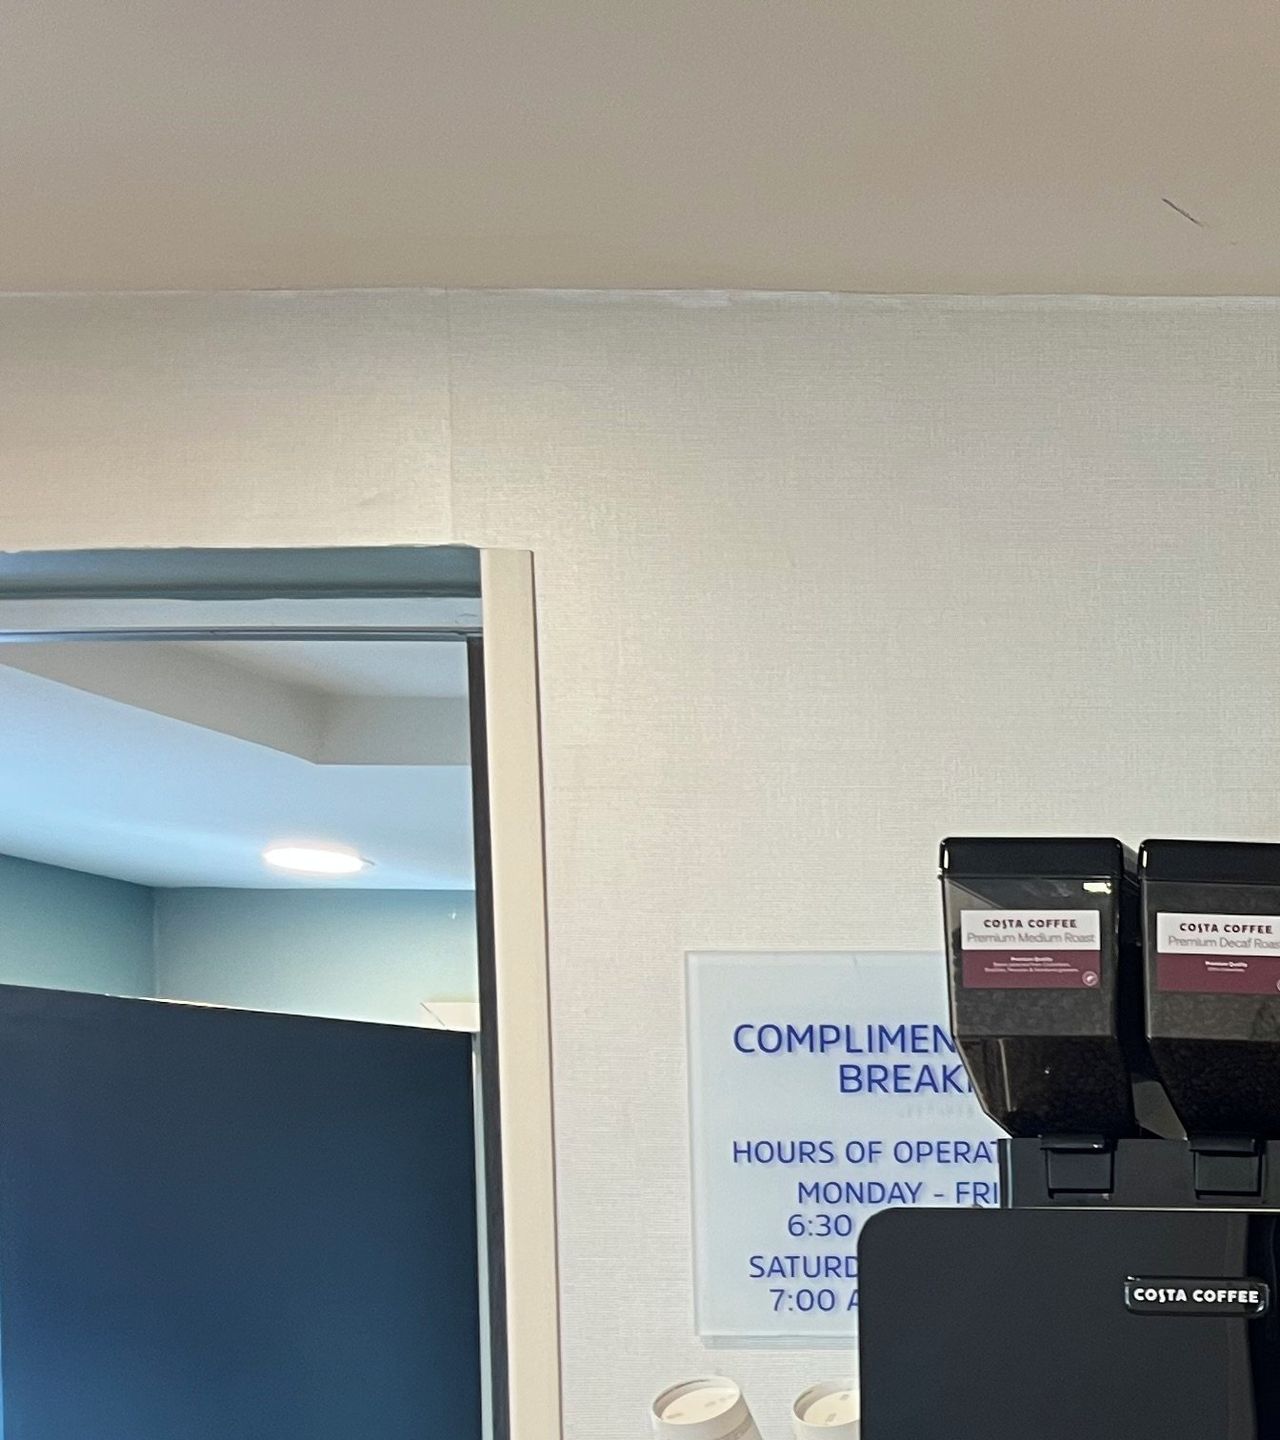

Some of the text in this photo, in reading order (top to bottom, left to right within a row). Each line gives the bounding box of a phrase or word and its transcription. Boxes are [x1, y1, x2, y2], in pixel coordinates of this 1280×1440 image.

[983, 919, 1078, 929] COSTA COFFEE
[1179, 923, 1273, 934] COSTA COFFEE
[967, 932, 1096, 943] Premium Medium Roast
[1168, 936, 1217, 947] Premium
[1219, 937, 1251, 948] Decaf
[839, 1063, 974, 1094] BREAK
[732, 1140, 835, 1166] HOURS
[845, 1140, 883, 1164] OF
[797, 1181, 923, 1205] MONDAY
[956, 1181, 998, 1204] FRI
[787, 1213, 853, 1237] 6:30
[748, 1255, 858, 1279] SATURD
[768, 1288, 836, 1312] 7:00
[1132, 1288, 1260, 1304] COSTA COFFEE
